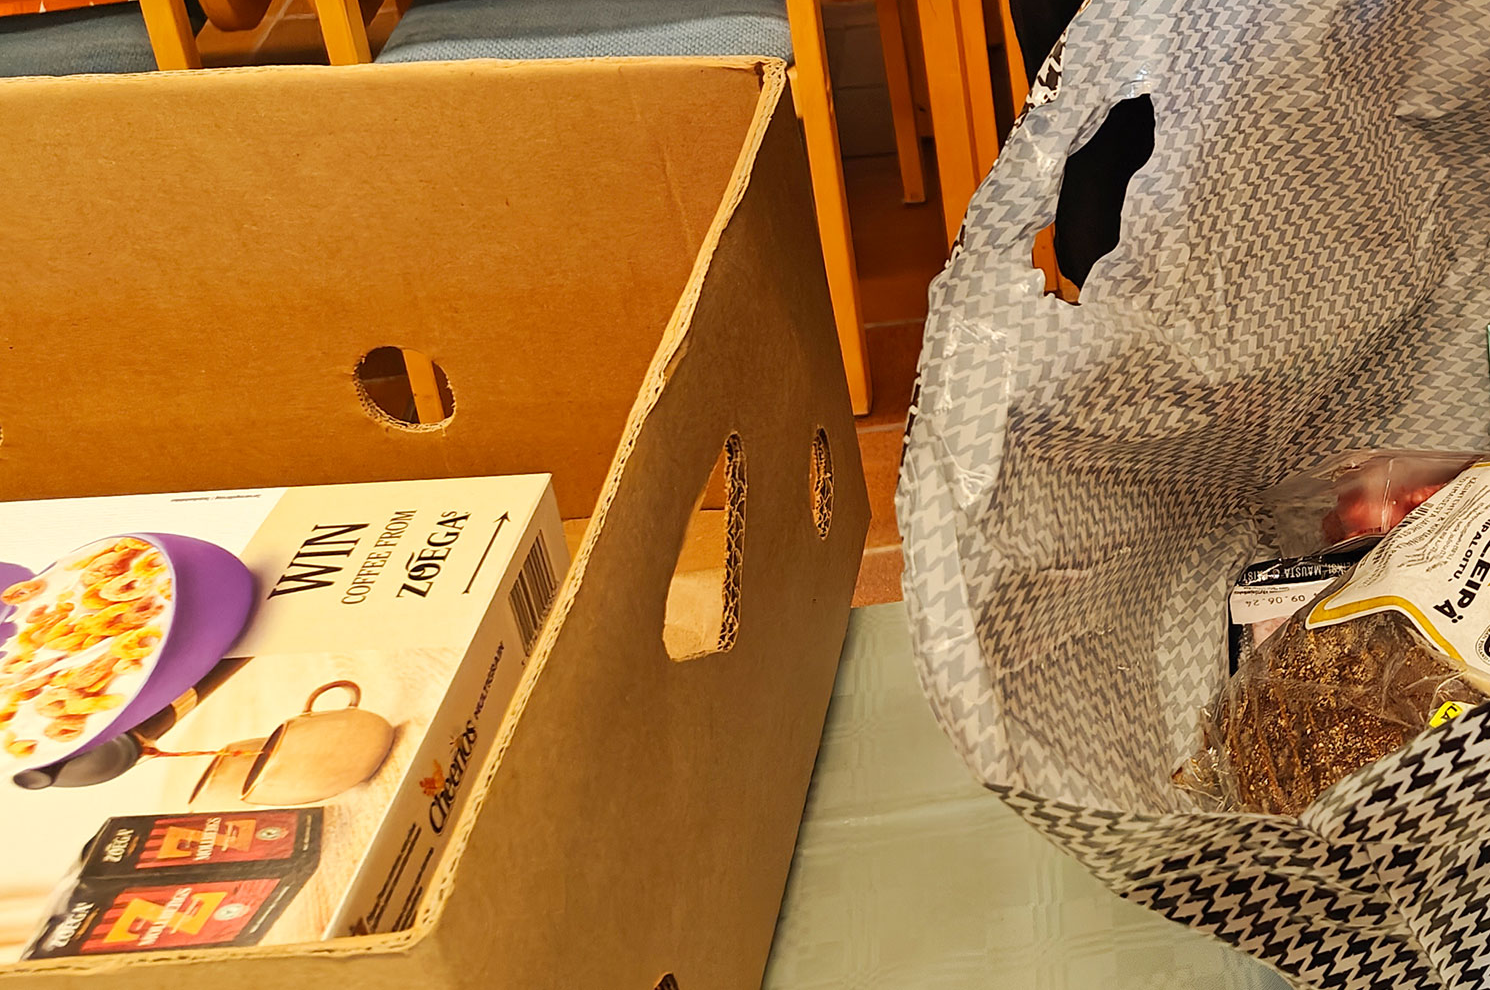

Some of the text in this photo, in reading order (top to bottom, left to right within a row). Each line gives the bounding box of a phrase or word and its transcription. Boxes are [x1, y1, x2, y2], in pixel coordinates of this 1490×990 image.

[268, 522, 373, 601] WIN
[339, 509, 417, 604] COFFEE FROM
[1284, 564, 1322, 579] MAUSTA
[428, 720, 478, 835] Cheerios
